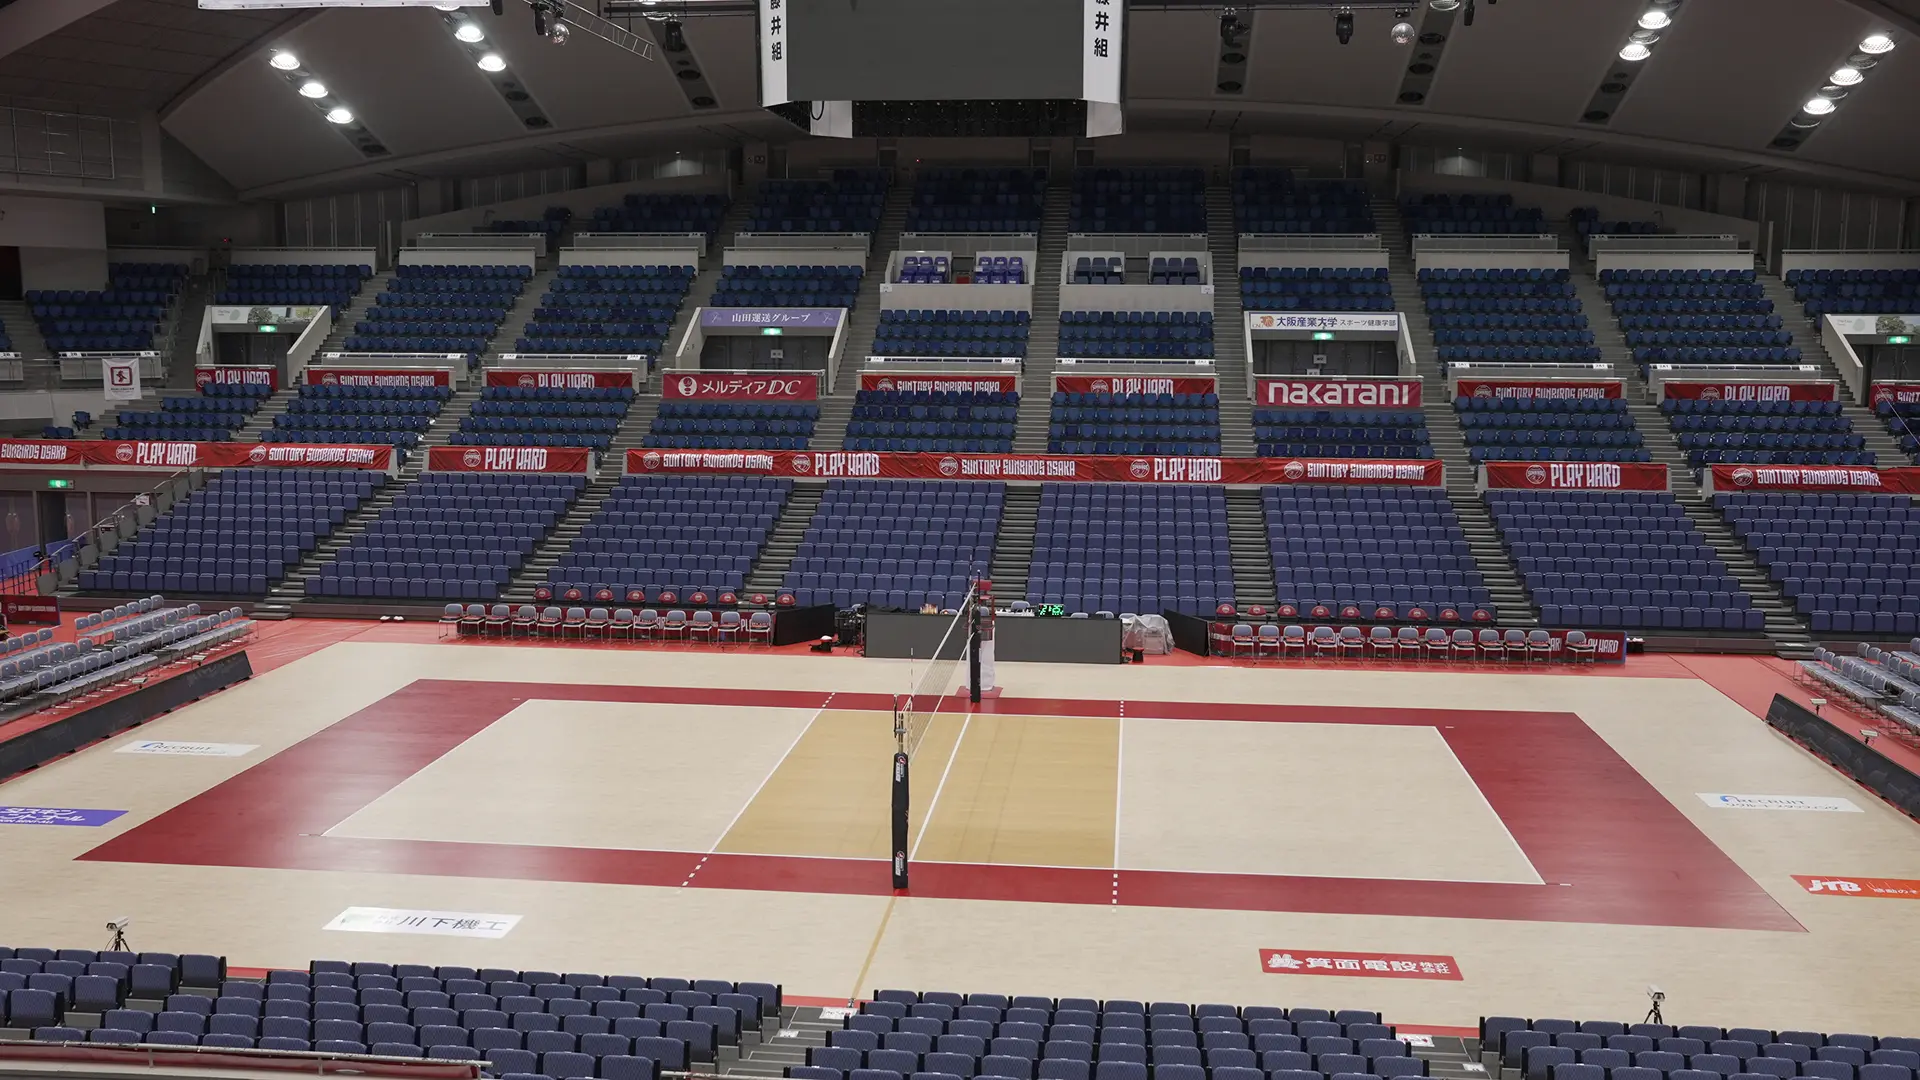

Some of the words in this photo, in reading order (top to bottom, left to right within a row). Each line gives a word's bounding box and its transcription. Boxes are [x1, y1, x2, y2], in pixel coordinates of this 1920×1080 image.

[1094, 0, 1111, 58] 井組
[732, 313, 811, 323] 山田運送グループ
[1276, 317, 1338, 328] 大阪産業大学
[1339, 319, 1397, 328] スポーツ健康学部
[40, 445, 67, 460] OSAKA
[136, 442, 165, 465] PLAY
[166, 443, 197, 465] HARD
[268, 447, 305, 461] SUNTORY
[306, 448, 346, 462] SUNBIRDS
[346, 448, 374, 464] OSAKA
[484, 447, 514, 470] PLAY
[515, 448, 547, 470] HARD
[663, 453, 701, 468] SUNTORY
[702, 453, 744, 469] SUNBIRDS
[745, 455, 774, 470] OSAKA
[815, 453, 845, 476] PLAY
[848, 453, 880, 476] HARD
[961, 459, 1001, 475] SUNTORY
[1002, 460, 1045, 476] SUNBIRDS
[1046, 461, 1076, 476] OSAKA
[1154, 458, 1186, 481] PLAY
[1188, 459, 1221, 481] HARD
[1307, 462, 1349, 478] SUNTORY
[1350, 463, 1394, 479] SUNBIRDS
[1395, 464, 1425, 480] OSAKA
[1551, 464, 1585, 487] PLAY
[1586, 464, 1621, 487] HARD
[1755, 469, 1800, 485] SUNTORY
[1801, 470, 1849, 486] SUNBIRDS
[1808, 880, 1861, 892] JTB
